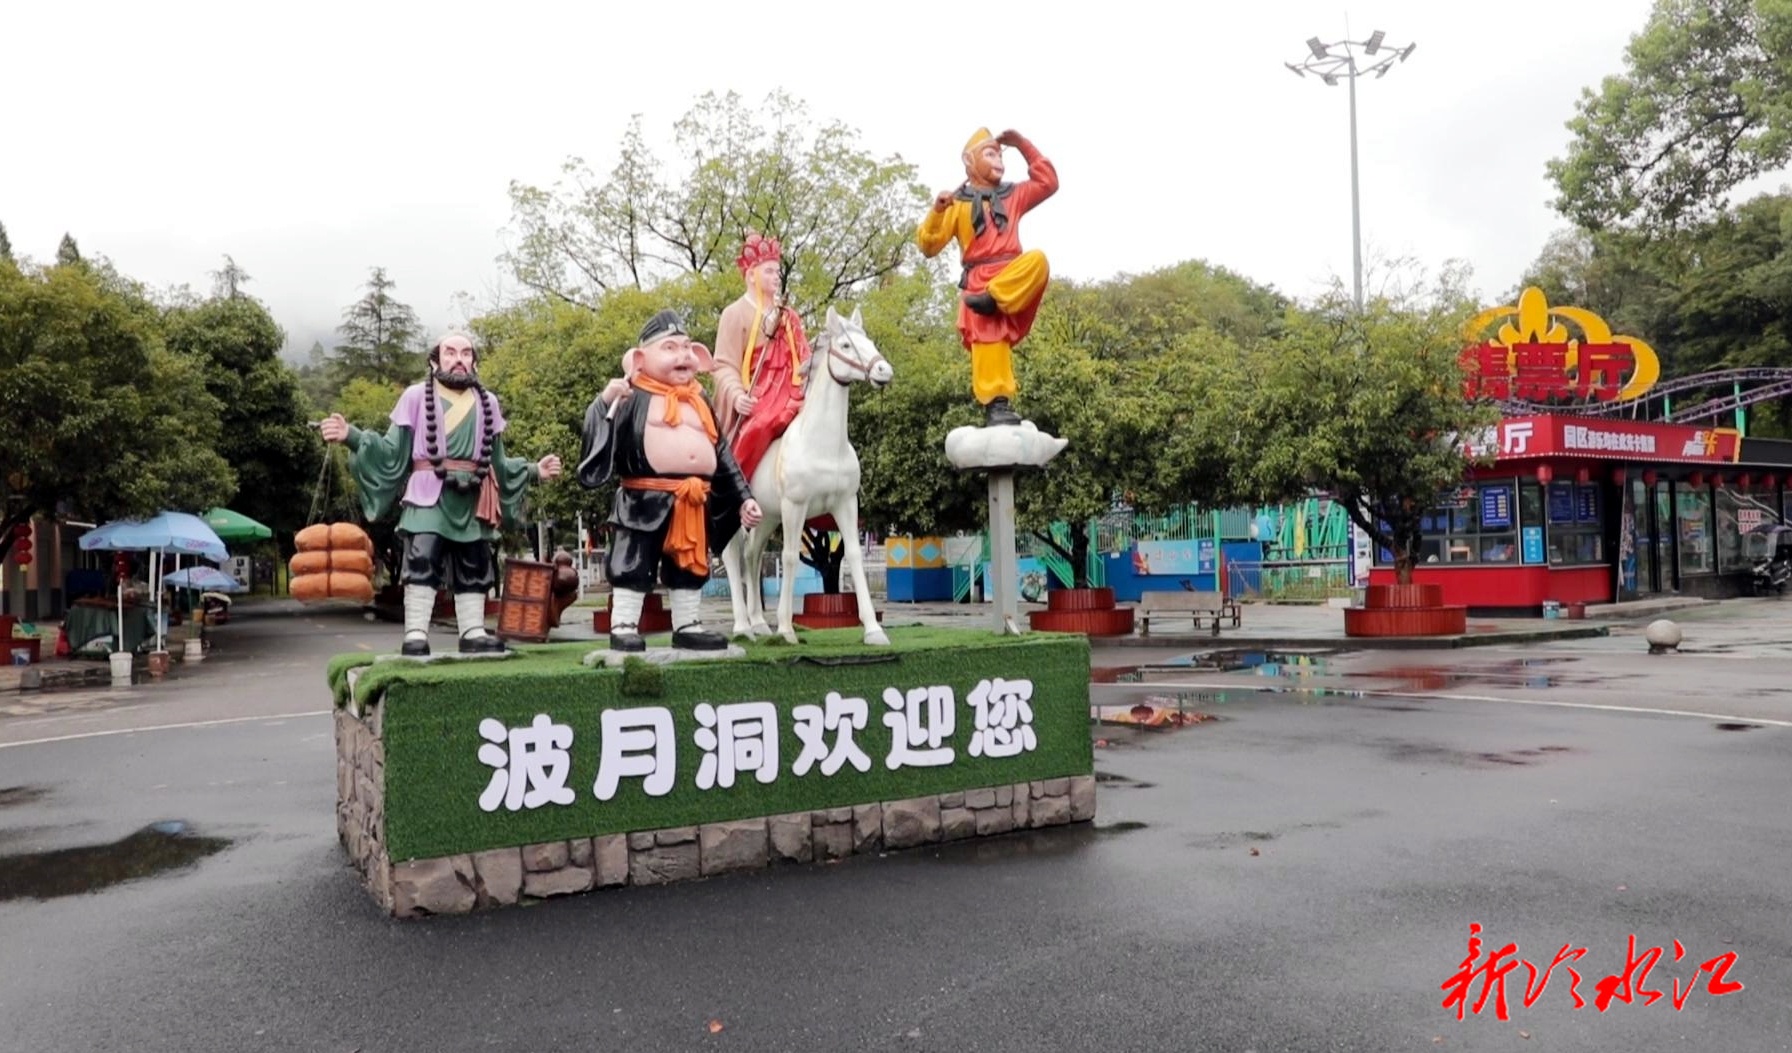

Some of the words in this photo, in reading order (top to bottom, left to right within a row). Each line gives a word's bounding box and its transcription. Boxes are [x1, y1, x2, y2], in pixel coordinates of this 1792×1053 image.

[477, 677, 1037, 812] 波月洞欢迎您
